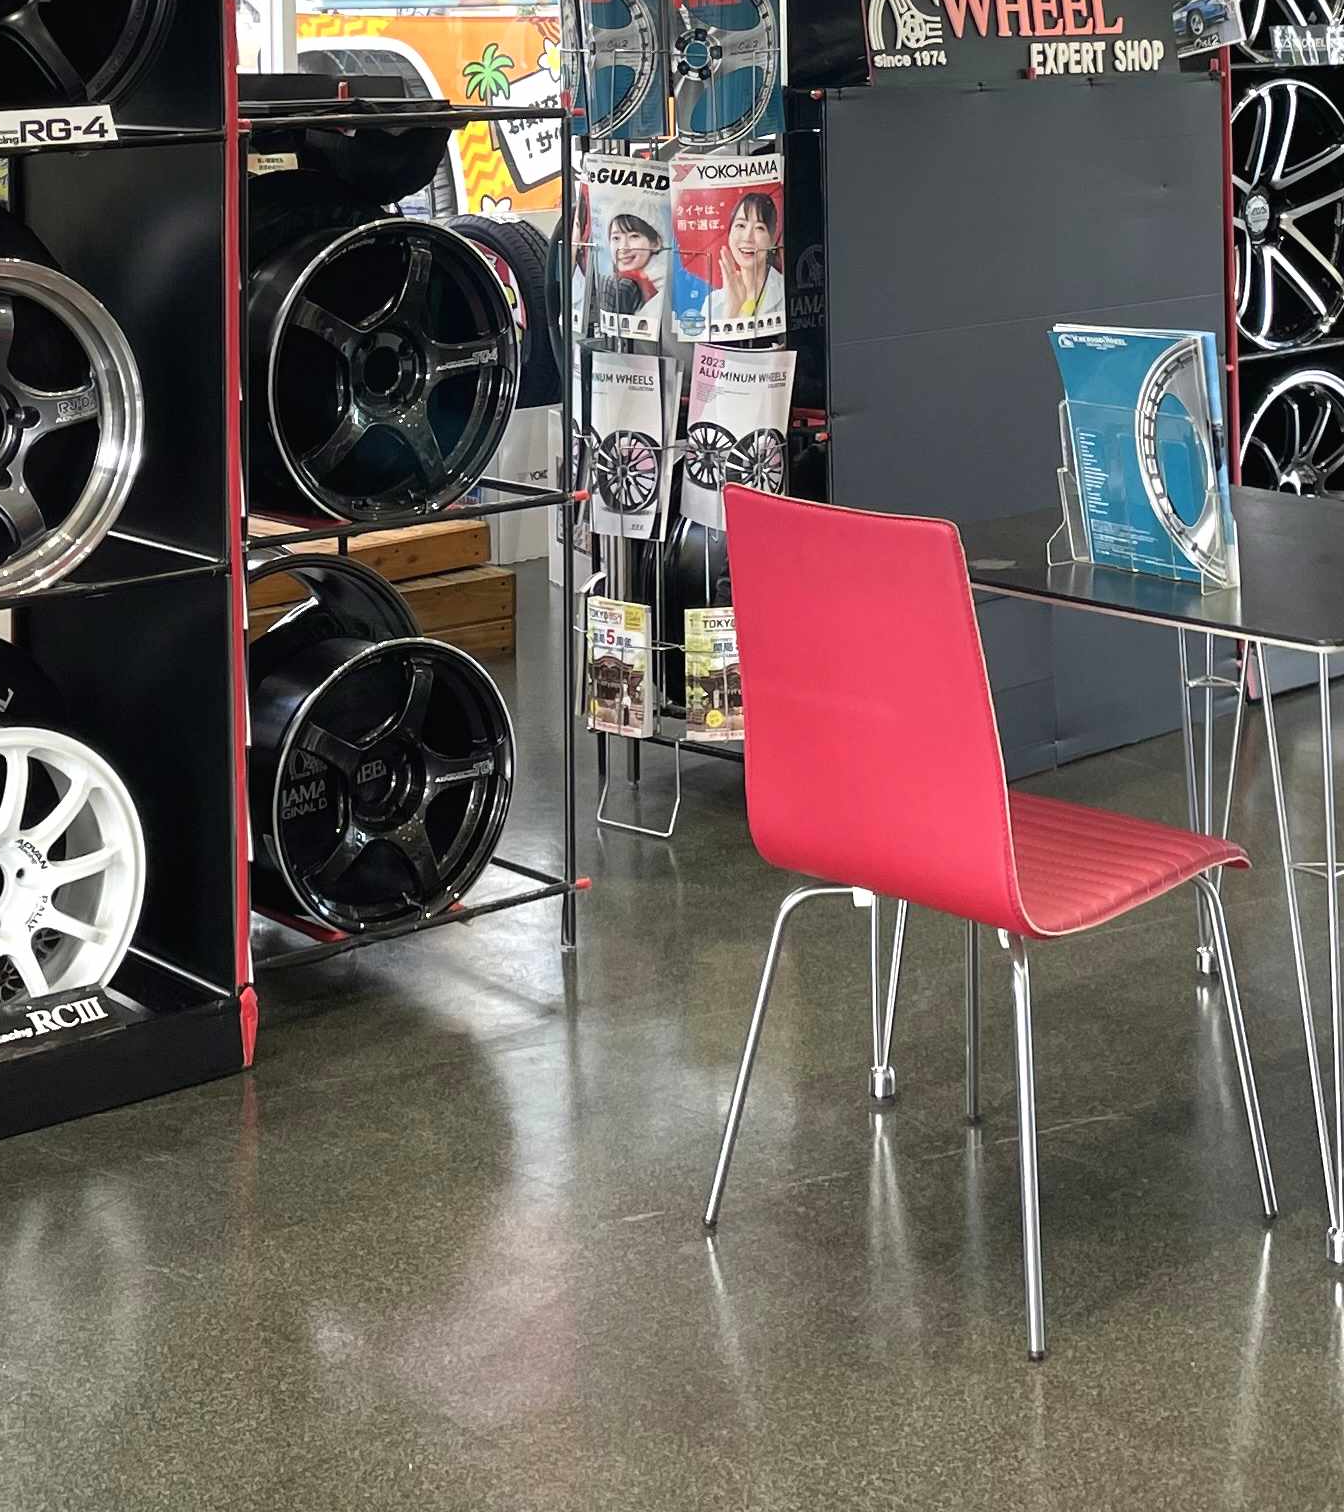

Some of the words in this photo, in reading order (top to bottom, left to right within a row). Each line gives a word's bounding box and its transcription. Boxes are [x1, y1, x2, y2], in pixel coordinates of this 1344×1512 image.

[873, 53, 912, 68] since
[913, 50, 947, 67] 1974
[1030, 41, 1106, 75] EXPERT
[1114, 39, 1166, 72] SHOP
[19, 116, 109, 144] RG-4
[696, 159, 778, 180] YOKOHAMA
[677, 204, 721, 217] タイヤは、
[677, 218, 726, 232] 雨で選ぼ。
[700, 355, 726, 369] 2023
[615, 373, 655, 386] WHEELS
[699, 366, 756, 384] ALUMINUM
[15, 838, 48, 870] ADVAN
[26, 895, 49, 933] RALLY
